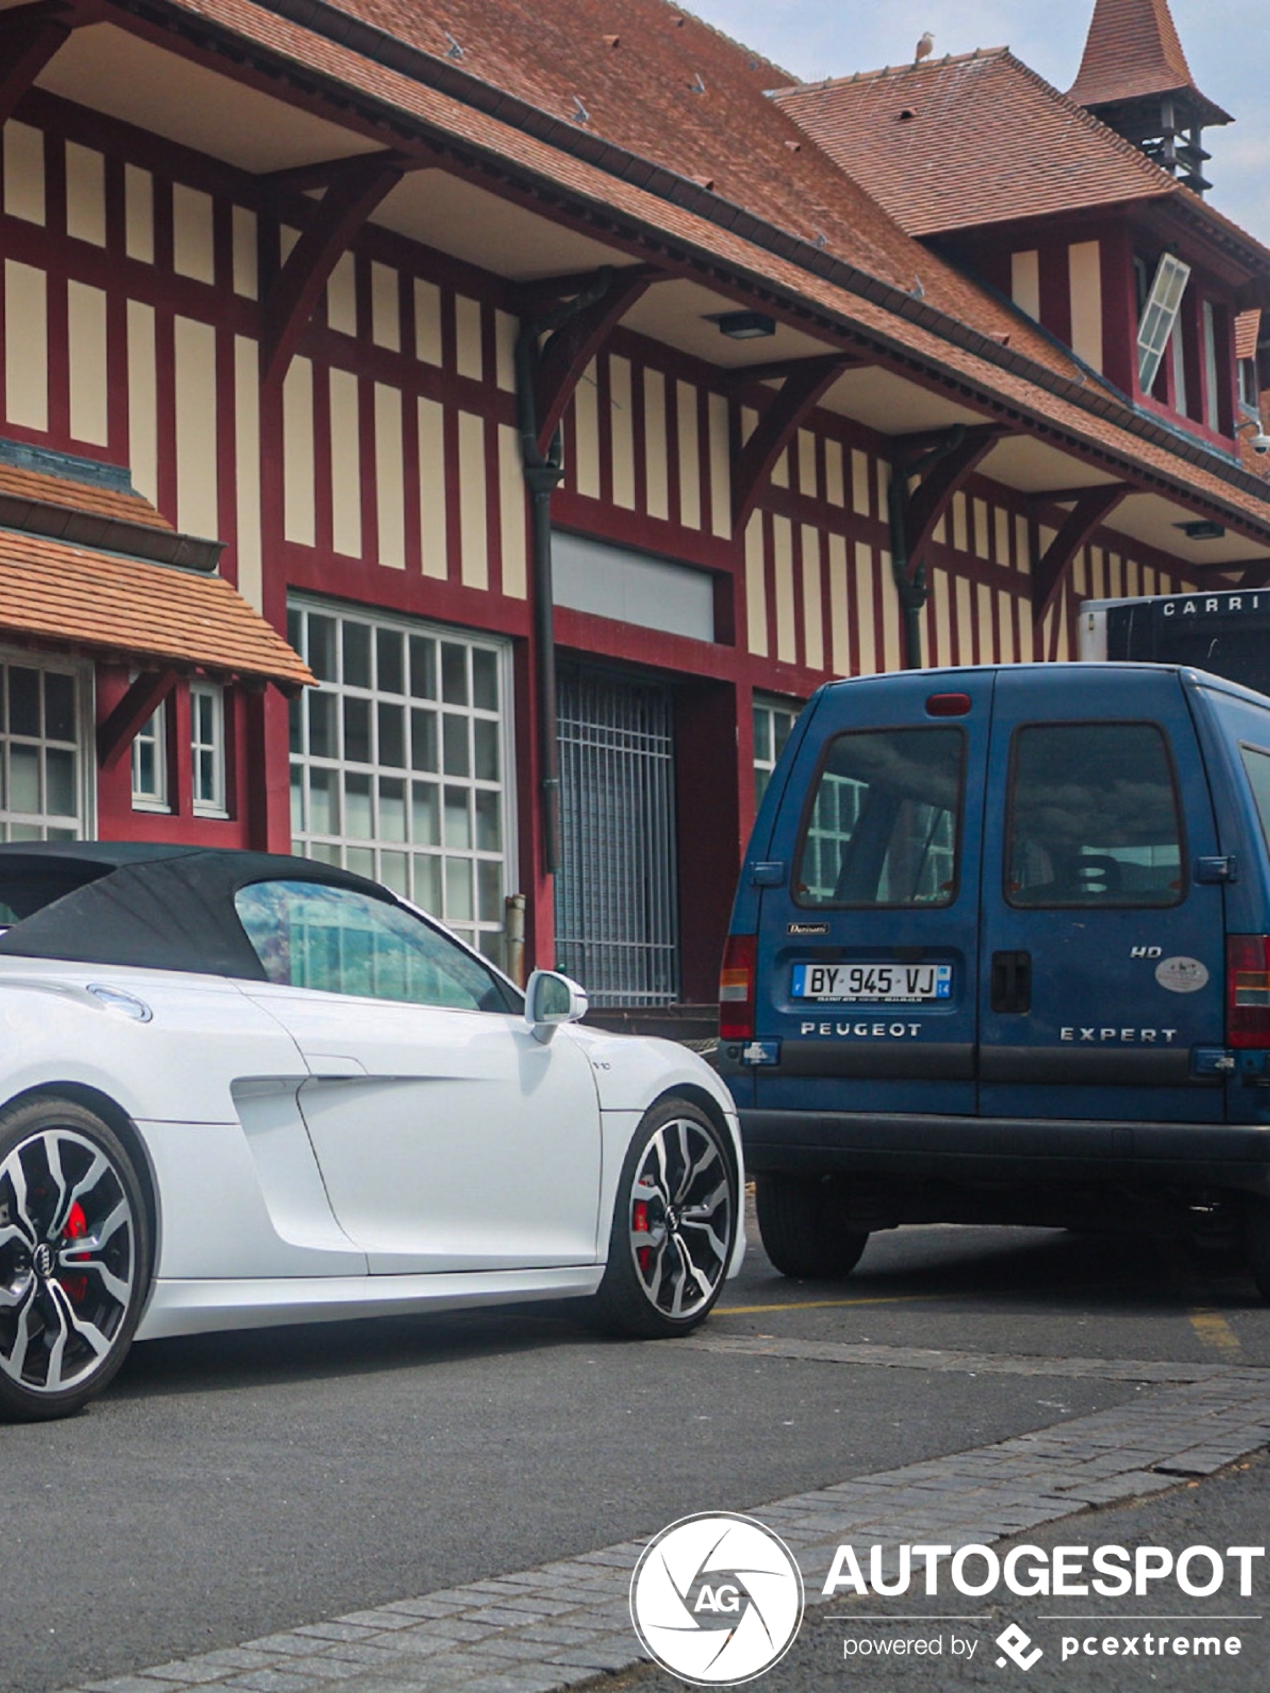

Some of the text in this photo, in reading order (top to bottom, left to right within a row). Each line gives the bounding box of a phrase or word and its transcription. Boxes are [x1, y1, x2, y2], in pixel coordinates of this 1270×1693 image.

[1130, 946, 1163, 959] HD
[800, 1021, 922, 1037] PEUGEOT
[1060, 1026, 1178, 1043] EXPERT
